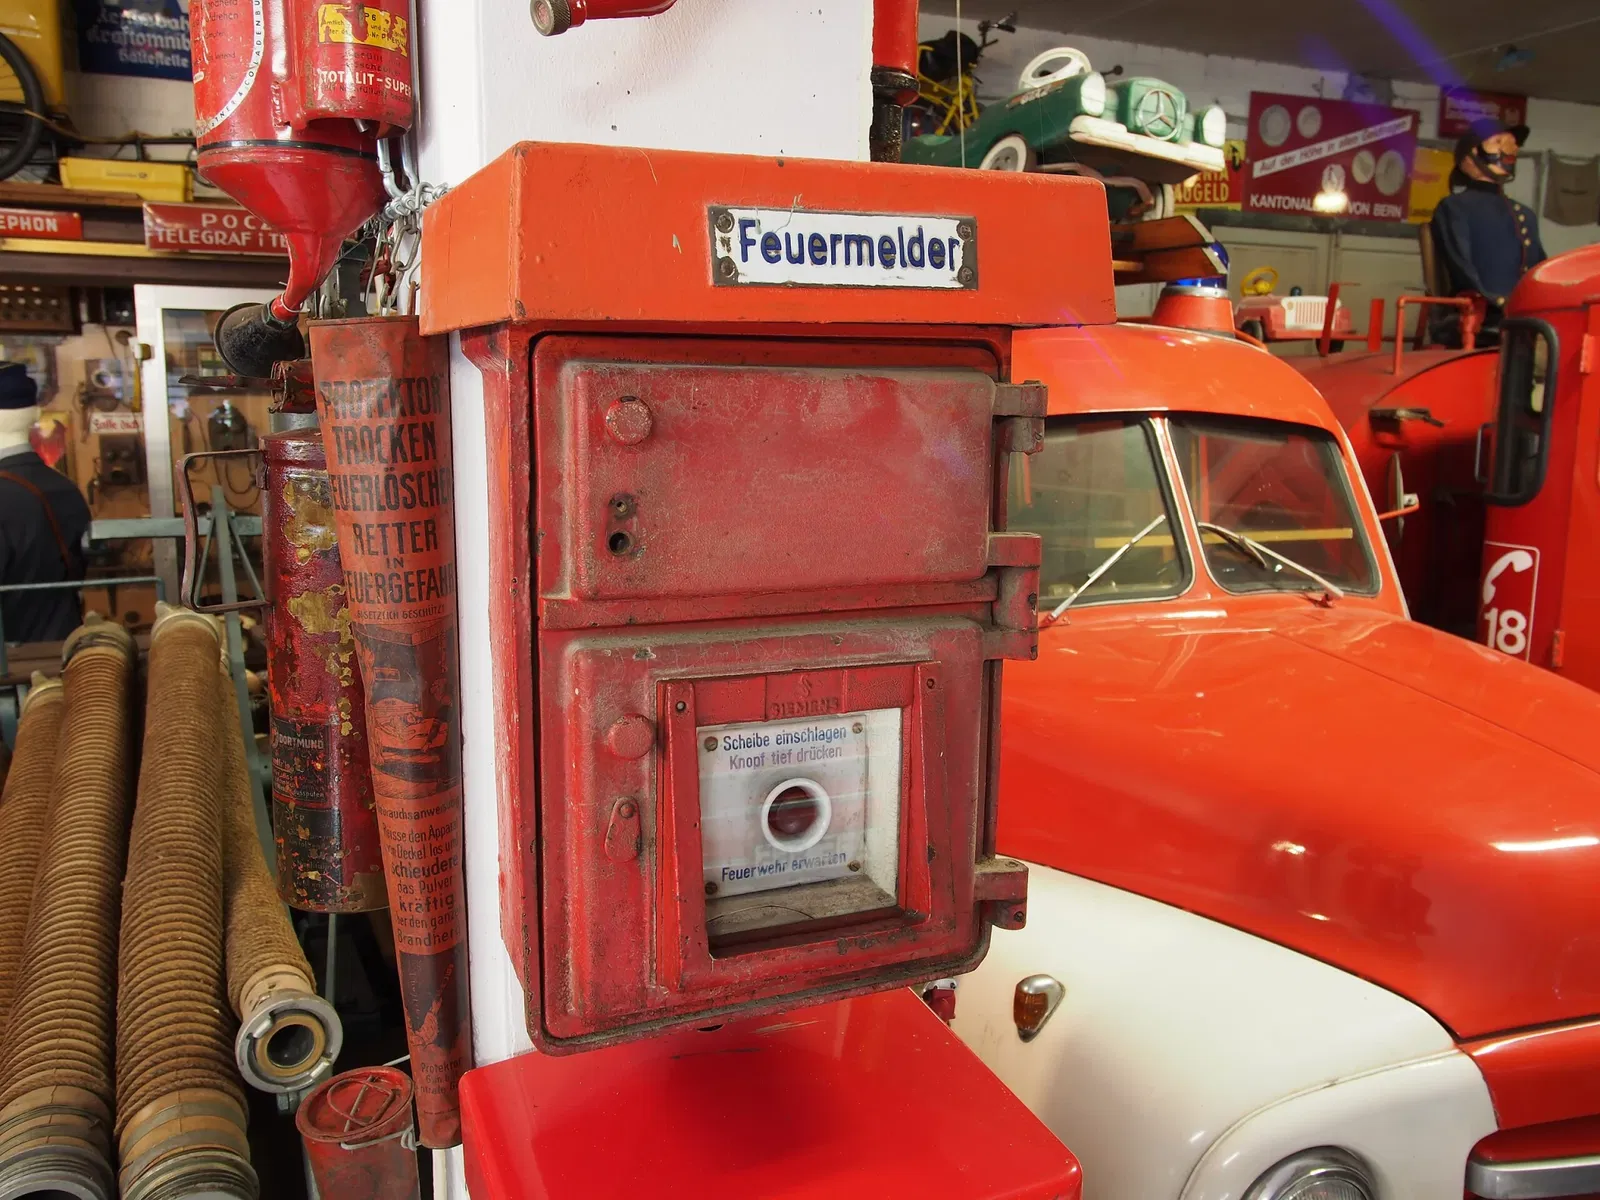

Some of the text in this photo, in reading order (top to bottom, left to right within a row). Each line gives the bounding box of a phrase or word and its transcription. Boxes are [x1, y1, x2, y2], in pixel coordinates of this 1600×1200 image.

[1250, 194, 1343, 214] KANTONAL
[1373, 203, 1402, 218] BERN
[156, 228, 252, 246] TELEGRAF
[738, 217, 960, 272] Feuermelder
[332, 421, 437, 465] TROCKEN
[352, 519, 438, 556] RETTER
[386, 557, 404, 569] IN
[1484, 607, 1527, 654] 18
[279, 733, 324, 750] DORTMUND
[723, 725, 847, 751] Scheibe einschlagen
[729, 745, 842, 771] Knopf tief drücken
[409, 828, 426, 843] den
[397, 843, 426, 860] Deckel
[430, 843, 443, 857] los
[721, 852, 847, 882] Feuerwehr erwarten
[397, 876, 453, 894] das Pulver
[399, 893, 454, 914] kräftig
[409, 914, 427, 928] den
[420, 1056, 462, 1073] Protektor
